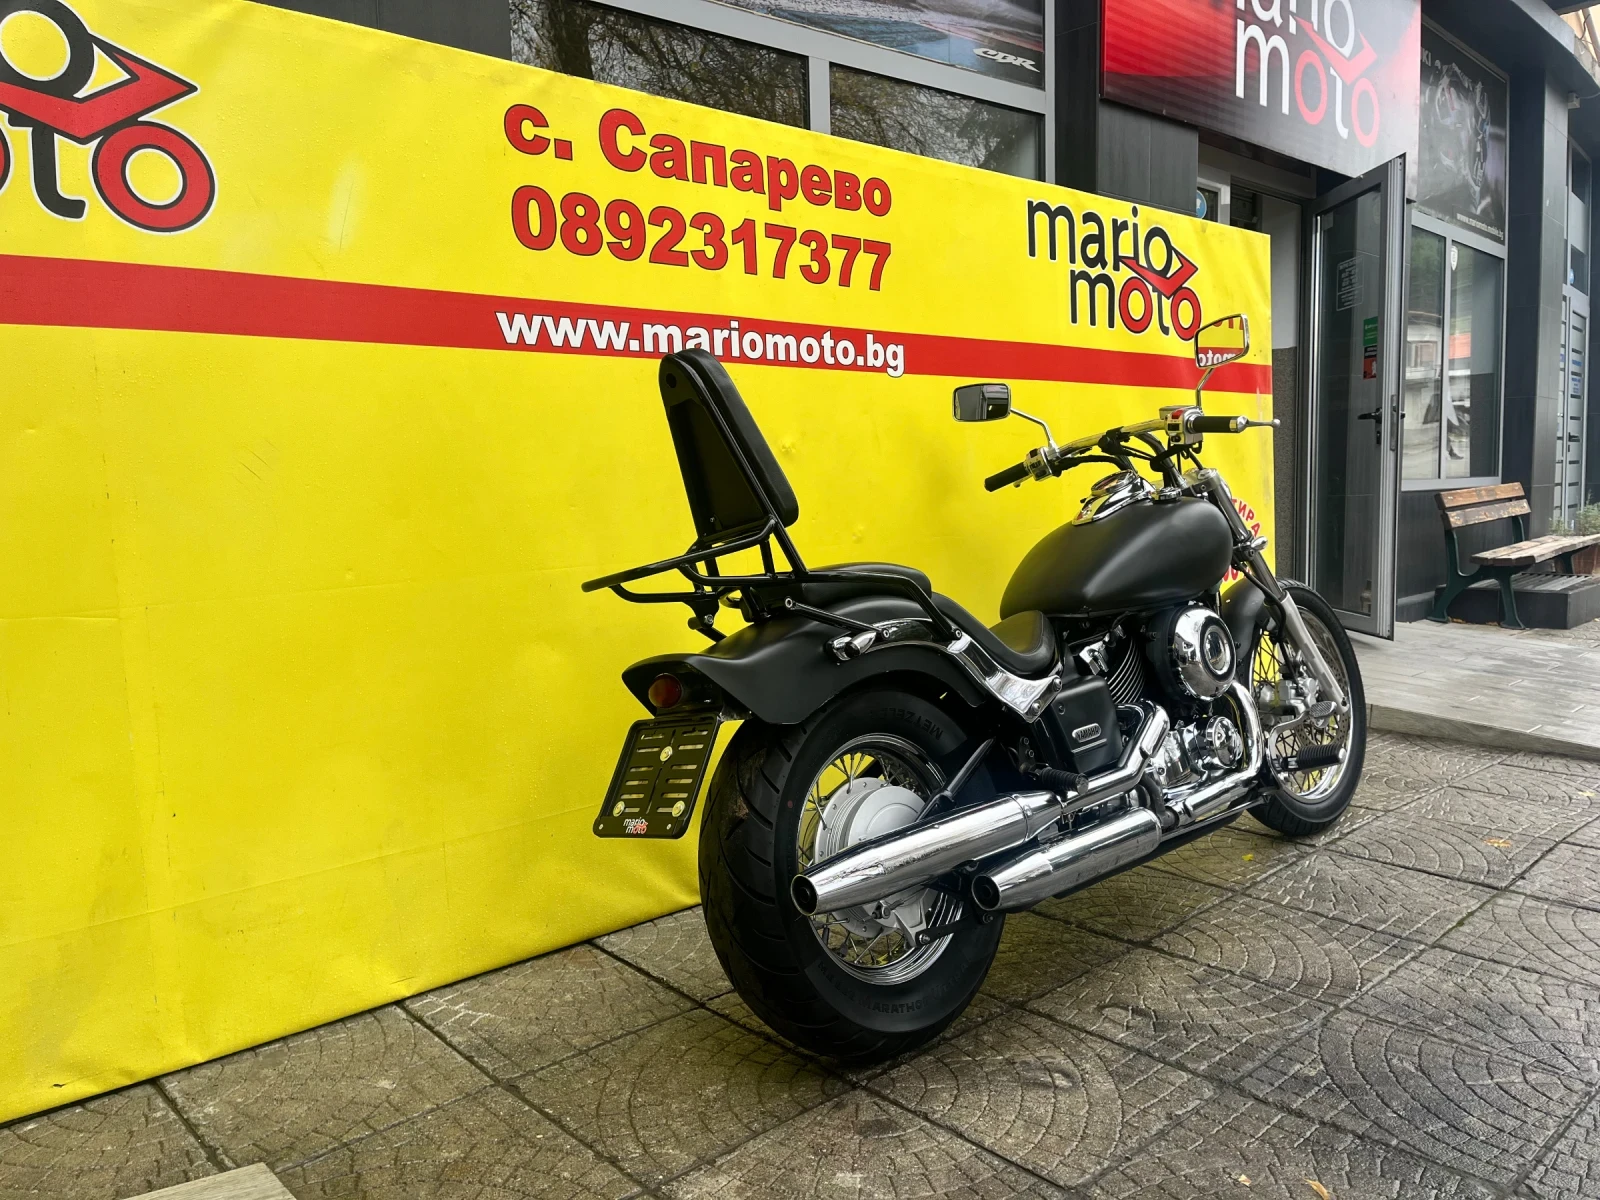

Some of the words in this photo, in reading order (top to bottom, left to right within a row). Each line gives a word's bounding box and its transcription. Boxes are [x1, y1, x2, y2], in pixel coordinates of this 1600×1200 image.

[972, 48, 1040, 72] CBR
[1236, 19, 1380, 148] moto
[503, 103, 573, 160] с.
[598, 108, 892, 217] Сапарево
[511, 184, 892, 291] 0892317377
[1027, 200, 1173, 278] mario
[1070, 269, 1202, 341] moto
[495, 311, 906, 378] www.mariomoto.bg
[871, 707, 944, 741] METZELE
[1075, 725, 1100, 741] YAMAHA
